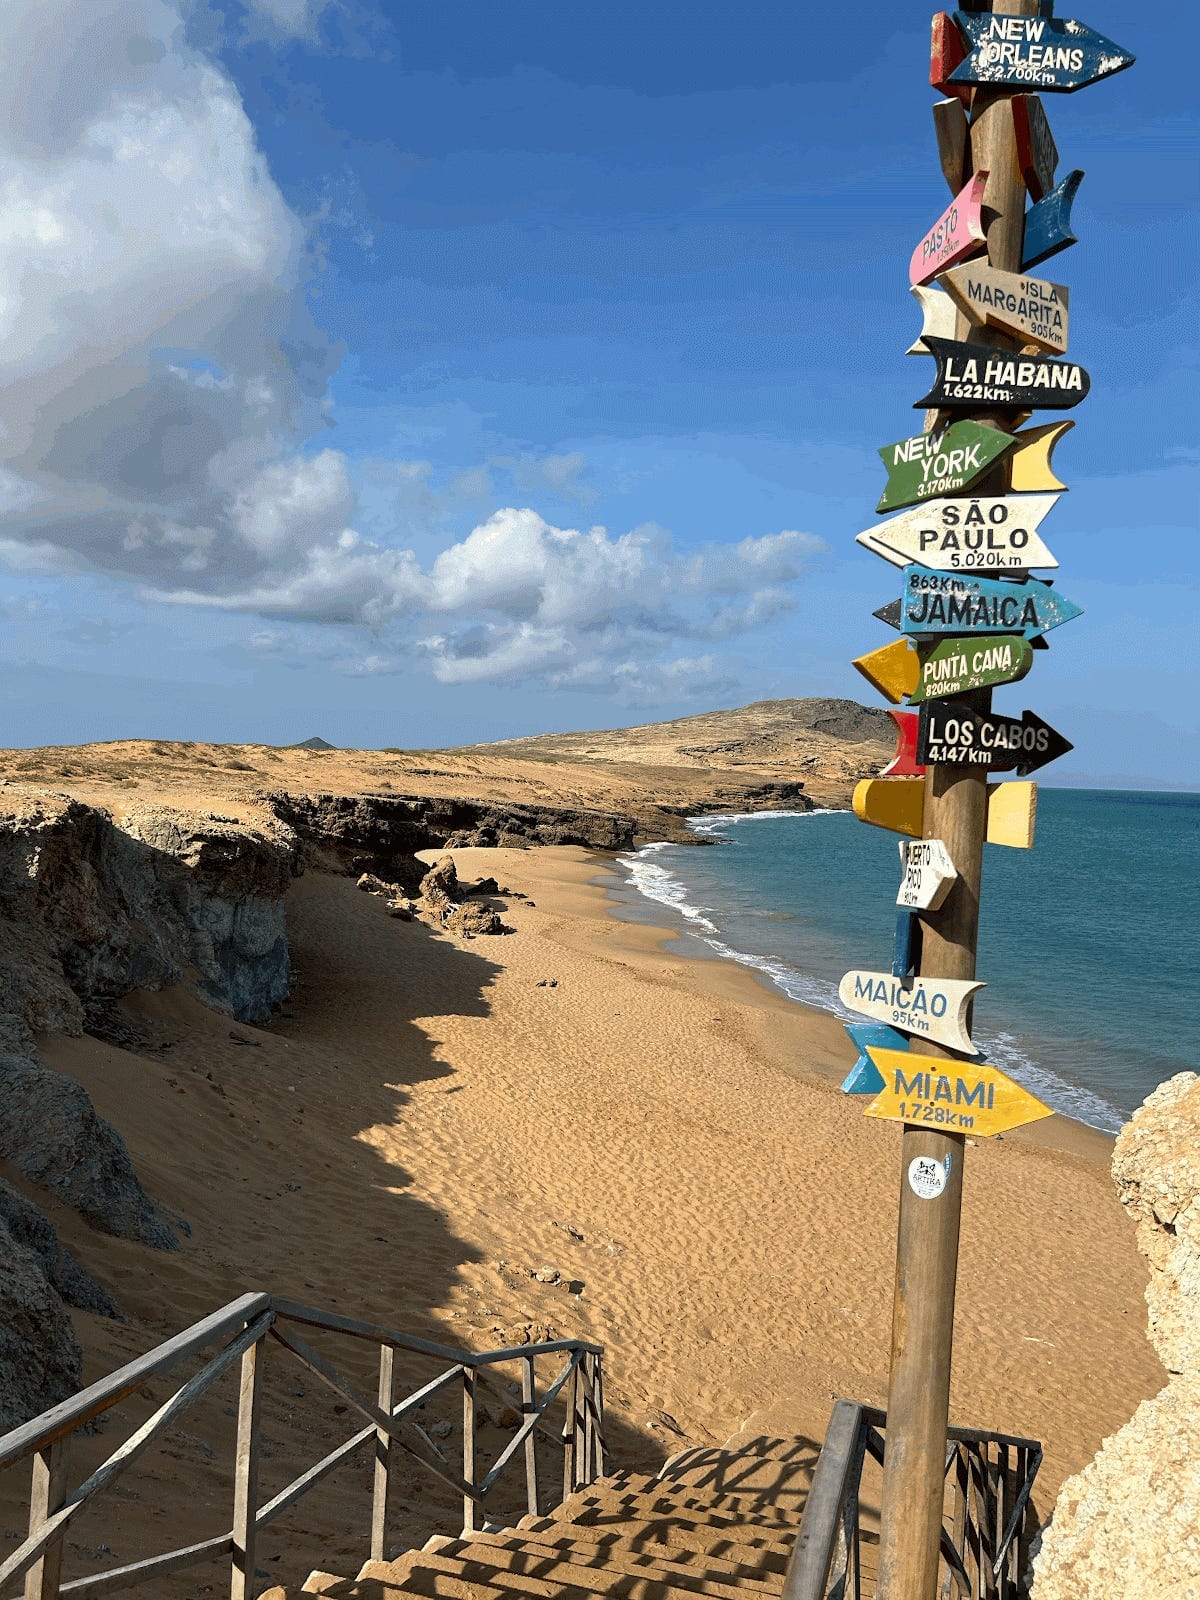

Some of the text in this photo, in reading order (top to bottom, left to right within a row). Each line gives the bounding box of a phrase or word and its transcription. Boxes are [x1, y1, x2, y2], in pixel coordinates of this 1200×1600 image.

[989, 16, 1045, 42] NEW
[986, 42, 1084, 71] ORLEANS
[994, 65, 1056, 84] 2.700km
[922, 208, 958, 266] PASTO
[968, 279, 1063, 329] MARGARITA
[1025, 281, 1058, 304] ISLA
[1030, 322, 1063, 344] 905km
[944, 357, 1082, 390] LA HABANA
[943, 383, 1010, 401] 1.622km
[893, 431, 944, 465] NEW
[920, 443, 981, 482] YORK
[942, 499, 1008, 526] SÃO
[919, 528, 1028, 551] PAULO
[908, 593, 1040, 628] JAMAICA
[923, 644, 1012, 683] PUNTA CANA
[925, 680, 960, 697] 820km
[928, 717, 1049, 752] LOS CABOS
[928, 745, 992, 764] 4.147km
[905, 844, 931, 866] PUERTO
[906, 867, 922, 890] RICO
[892, 1010, 930, 1031] 95km
[894, 1068, 995, 1110] MIAMI
[899, 1102, 975, 1129] 1.728km
